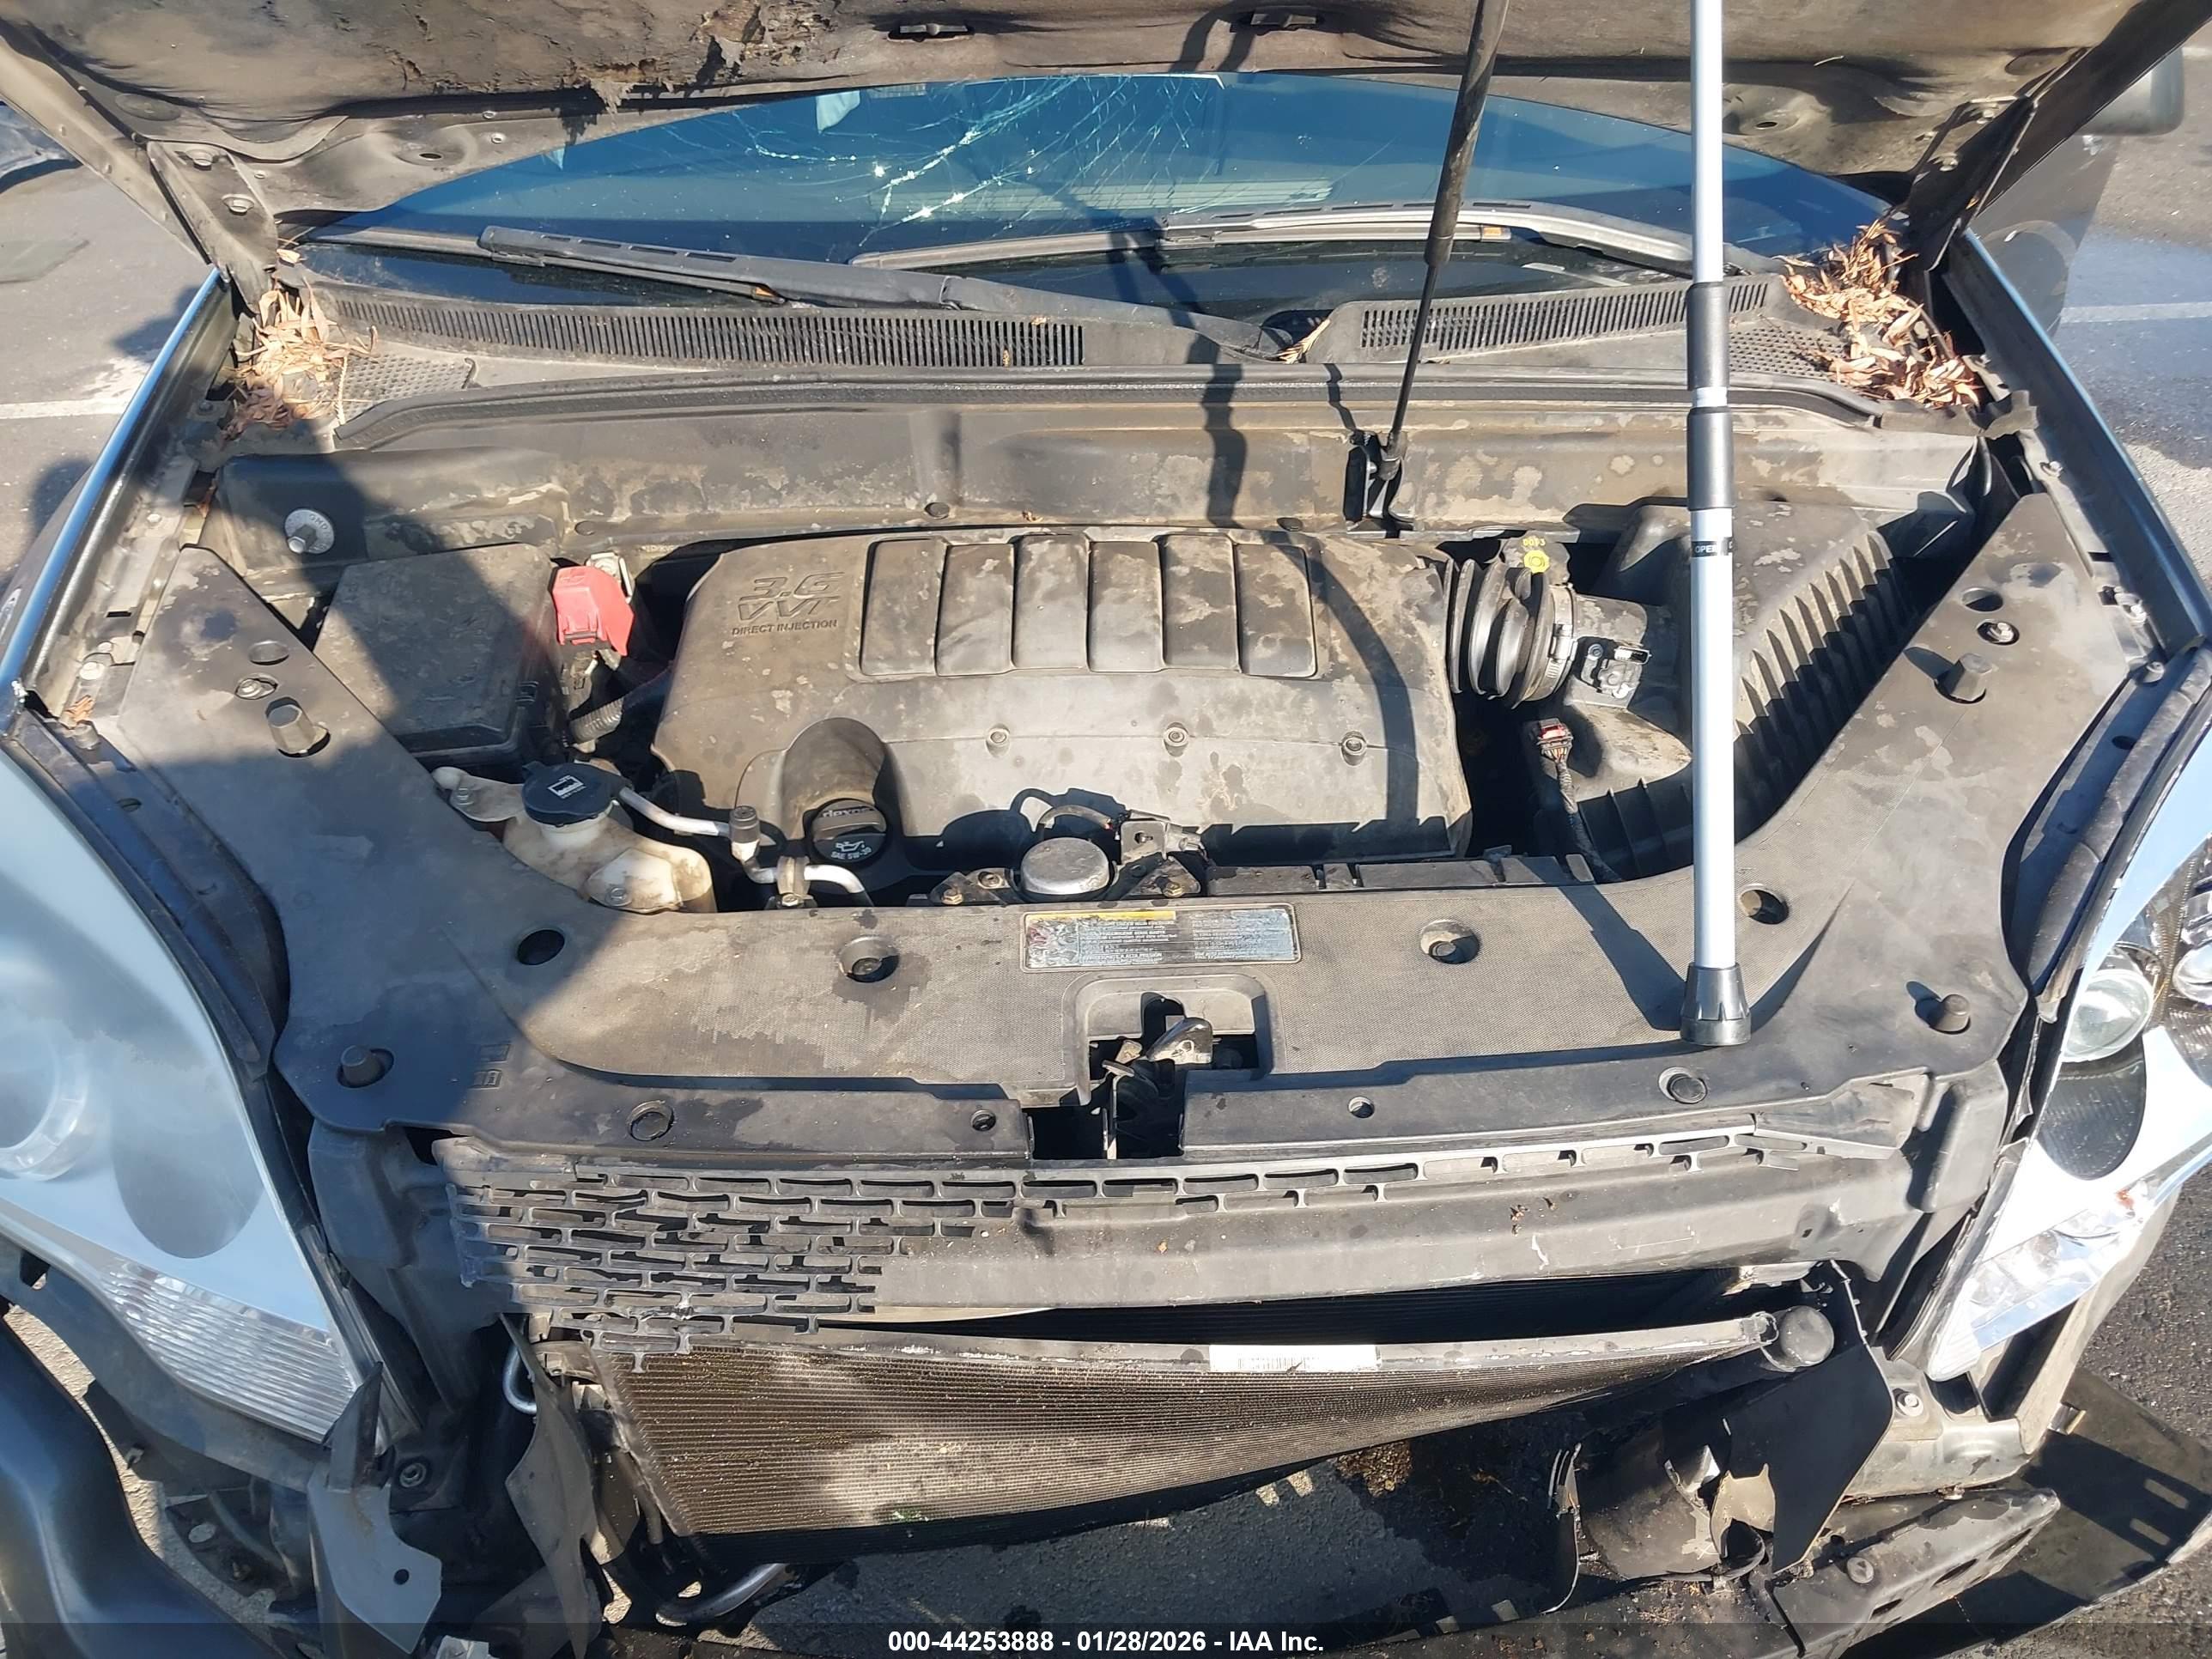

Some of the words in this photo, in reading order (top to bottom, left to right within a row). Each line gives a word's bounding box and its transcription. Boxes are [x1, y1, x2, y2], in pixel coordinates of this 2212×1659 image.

[738, 571, 845, 601] 3.6
[738, 595, 842, 621] VVT
[732, 623, 775, 635] DIRECT
[776, 619, 838, 632] INJECTION
